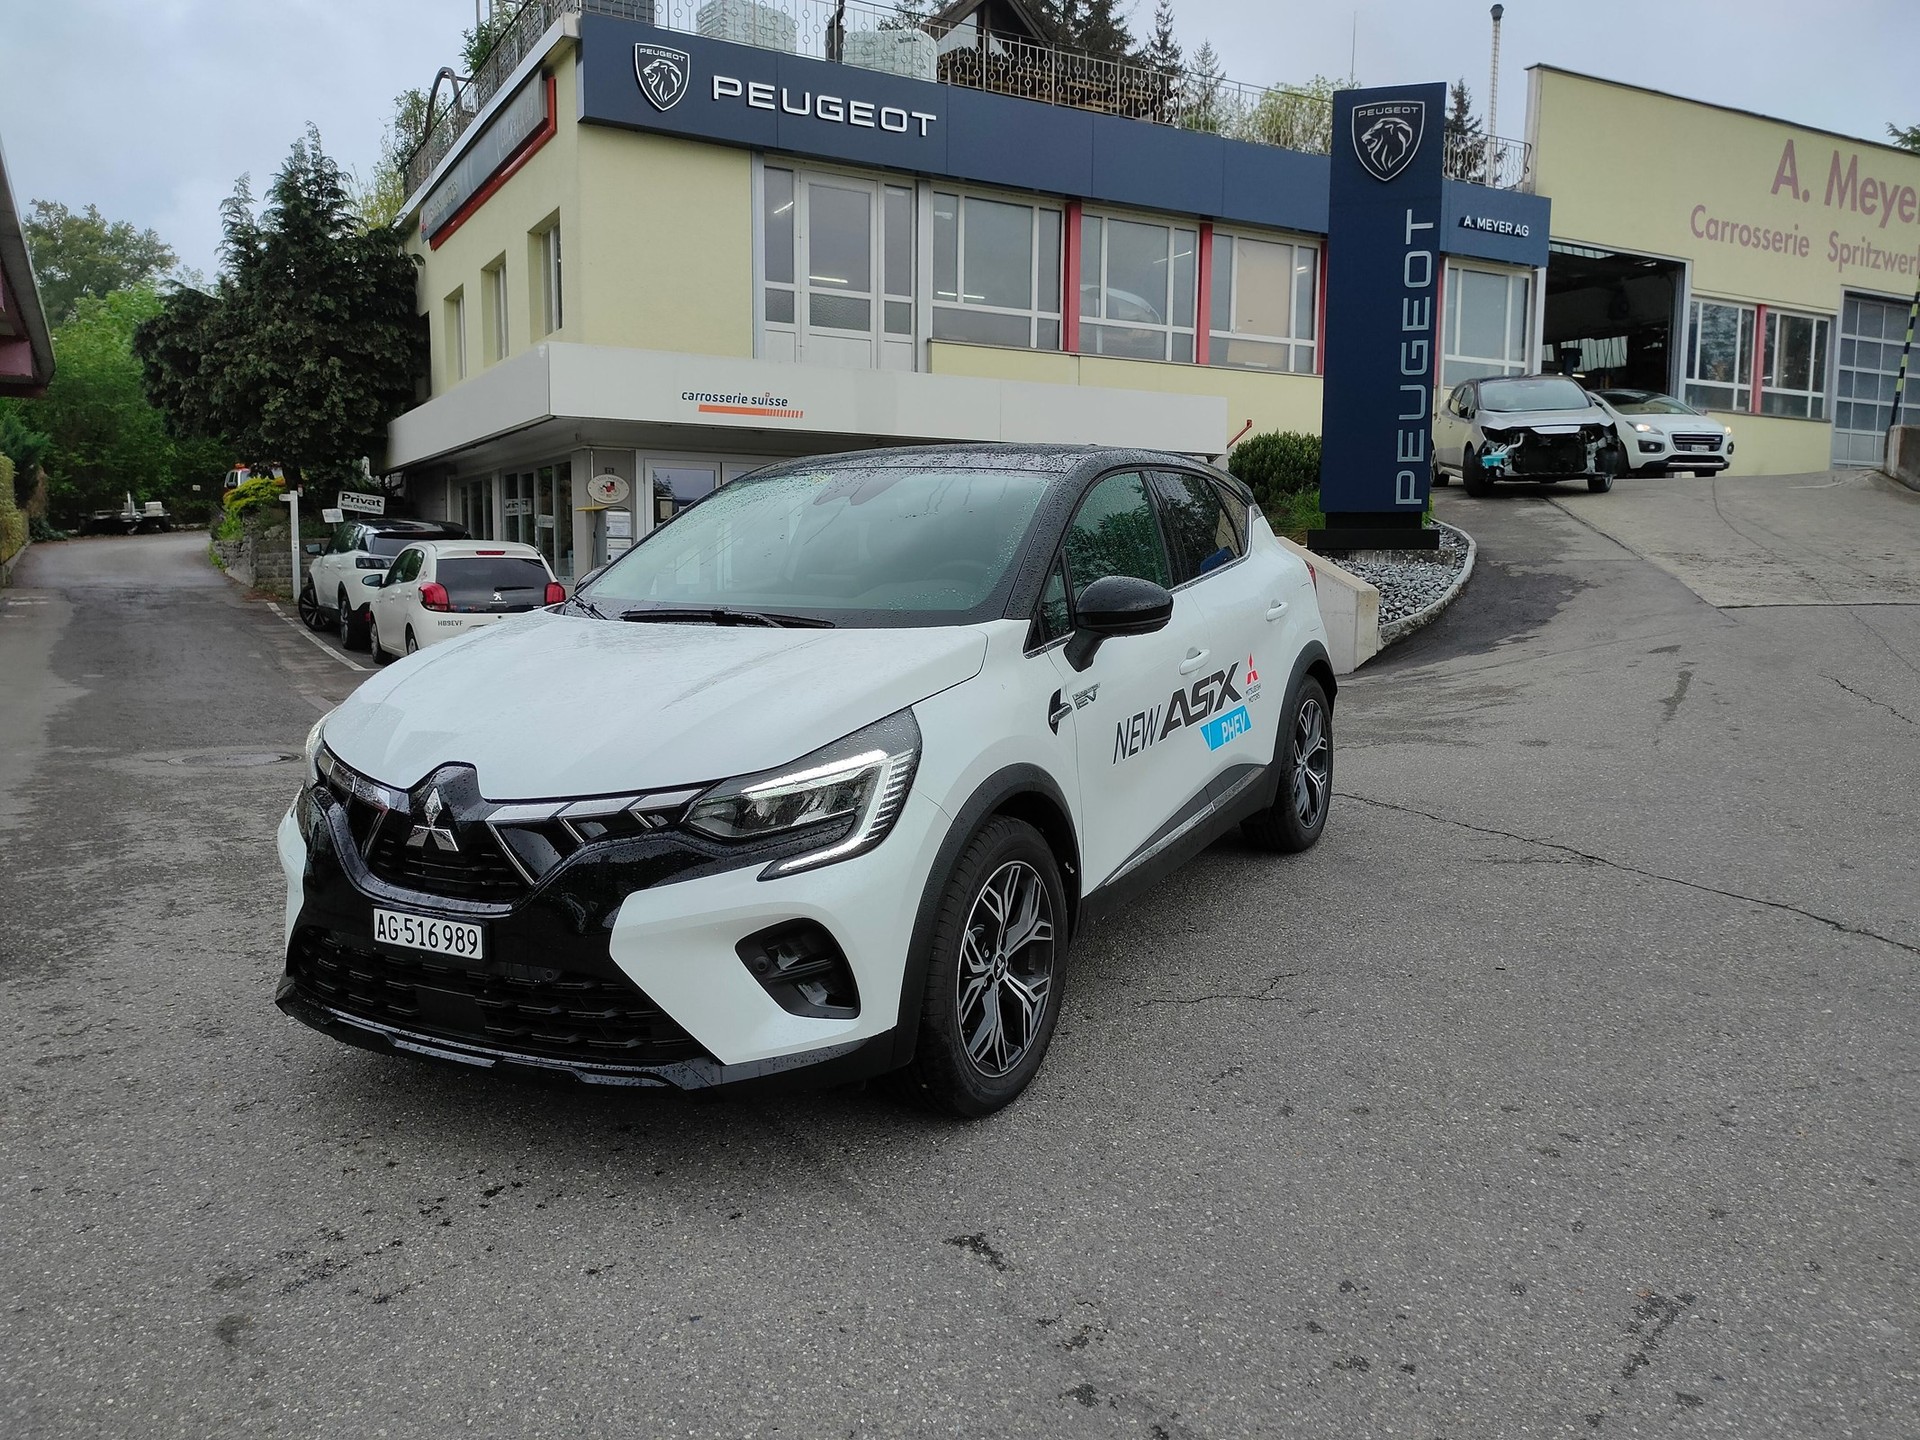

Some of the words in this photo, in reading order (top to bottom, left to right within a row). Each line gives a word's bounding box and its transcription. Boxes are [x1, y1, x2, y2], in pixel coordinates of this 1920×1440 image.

[640, 48, 685, 61] PEUGEOT
[713, 75, 937, 137] PEUGEOT
[1358, 106, 1419, 117] PEUGEOT
[1771, 138, 1810, 203] A.
[1824, 149, 1920, 229] Meye
[1463, 214, 1475, 228] A.
[1476, 216, 1513, 234] MEYER
[1514, 223, 1529, 237] AG
[1690, 204, 1810, 258] Carrosserie
[1395, 208, 1434, 505] PEUGEOT
[681, 391, 748, 404] carrosserie
[751, 392, 788, 407] suisse
[341, 493, 382, 507] Privat
[1112, 703, 1161, 765] NEW
[1158, 661, 1243, 742] ASX
[1221, 710, 1246, 744] PHEV
